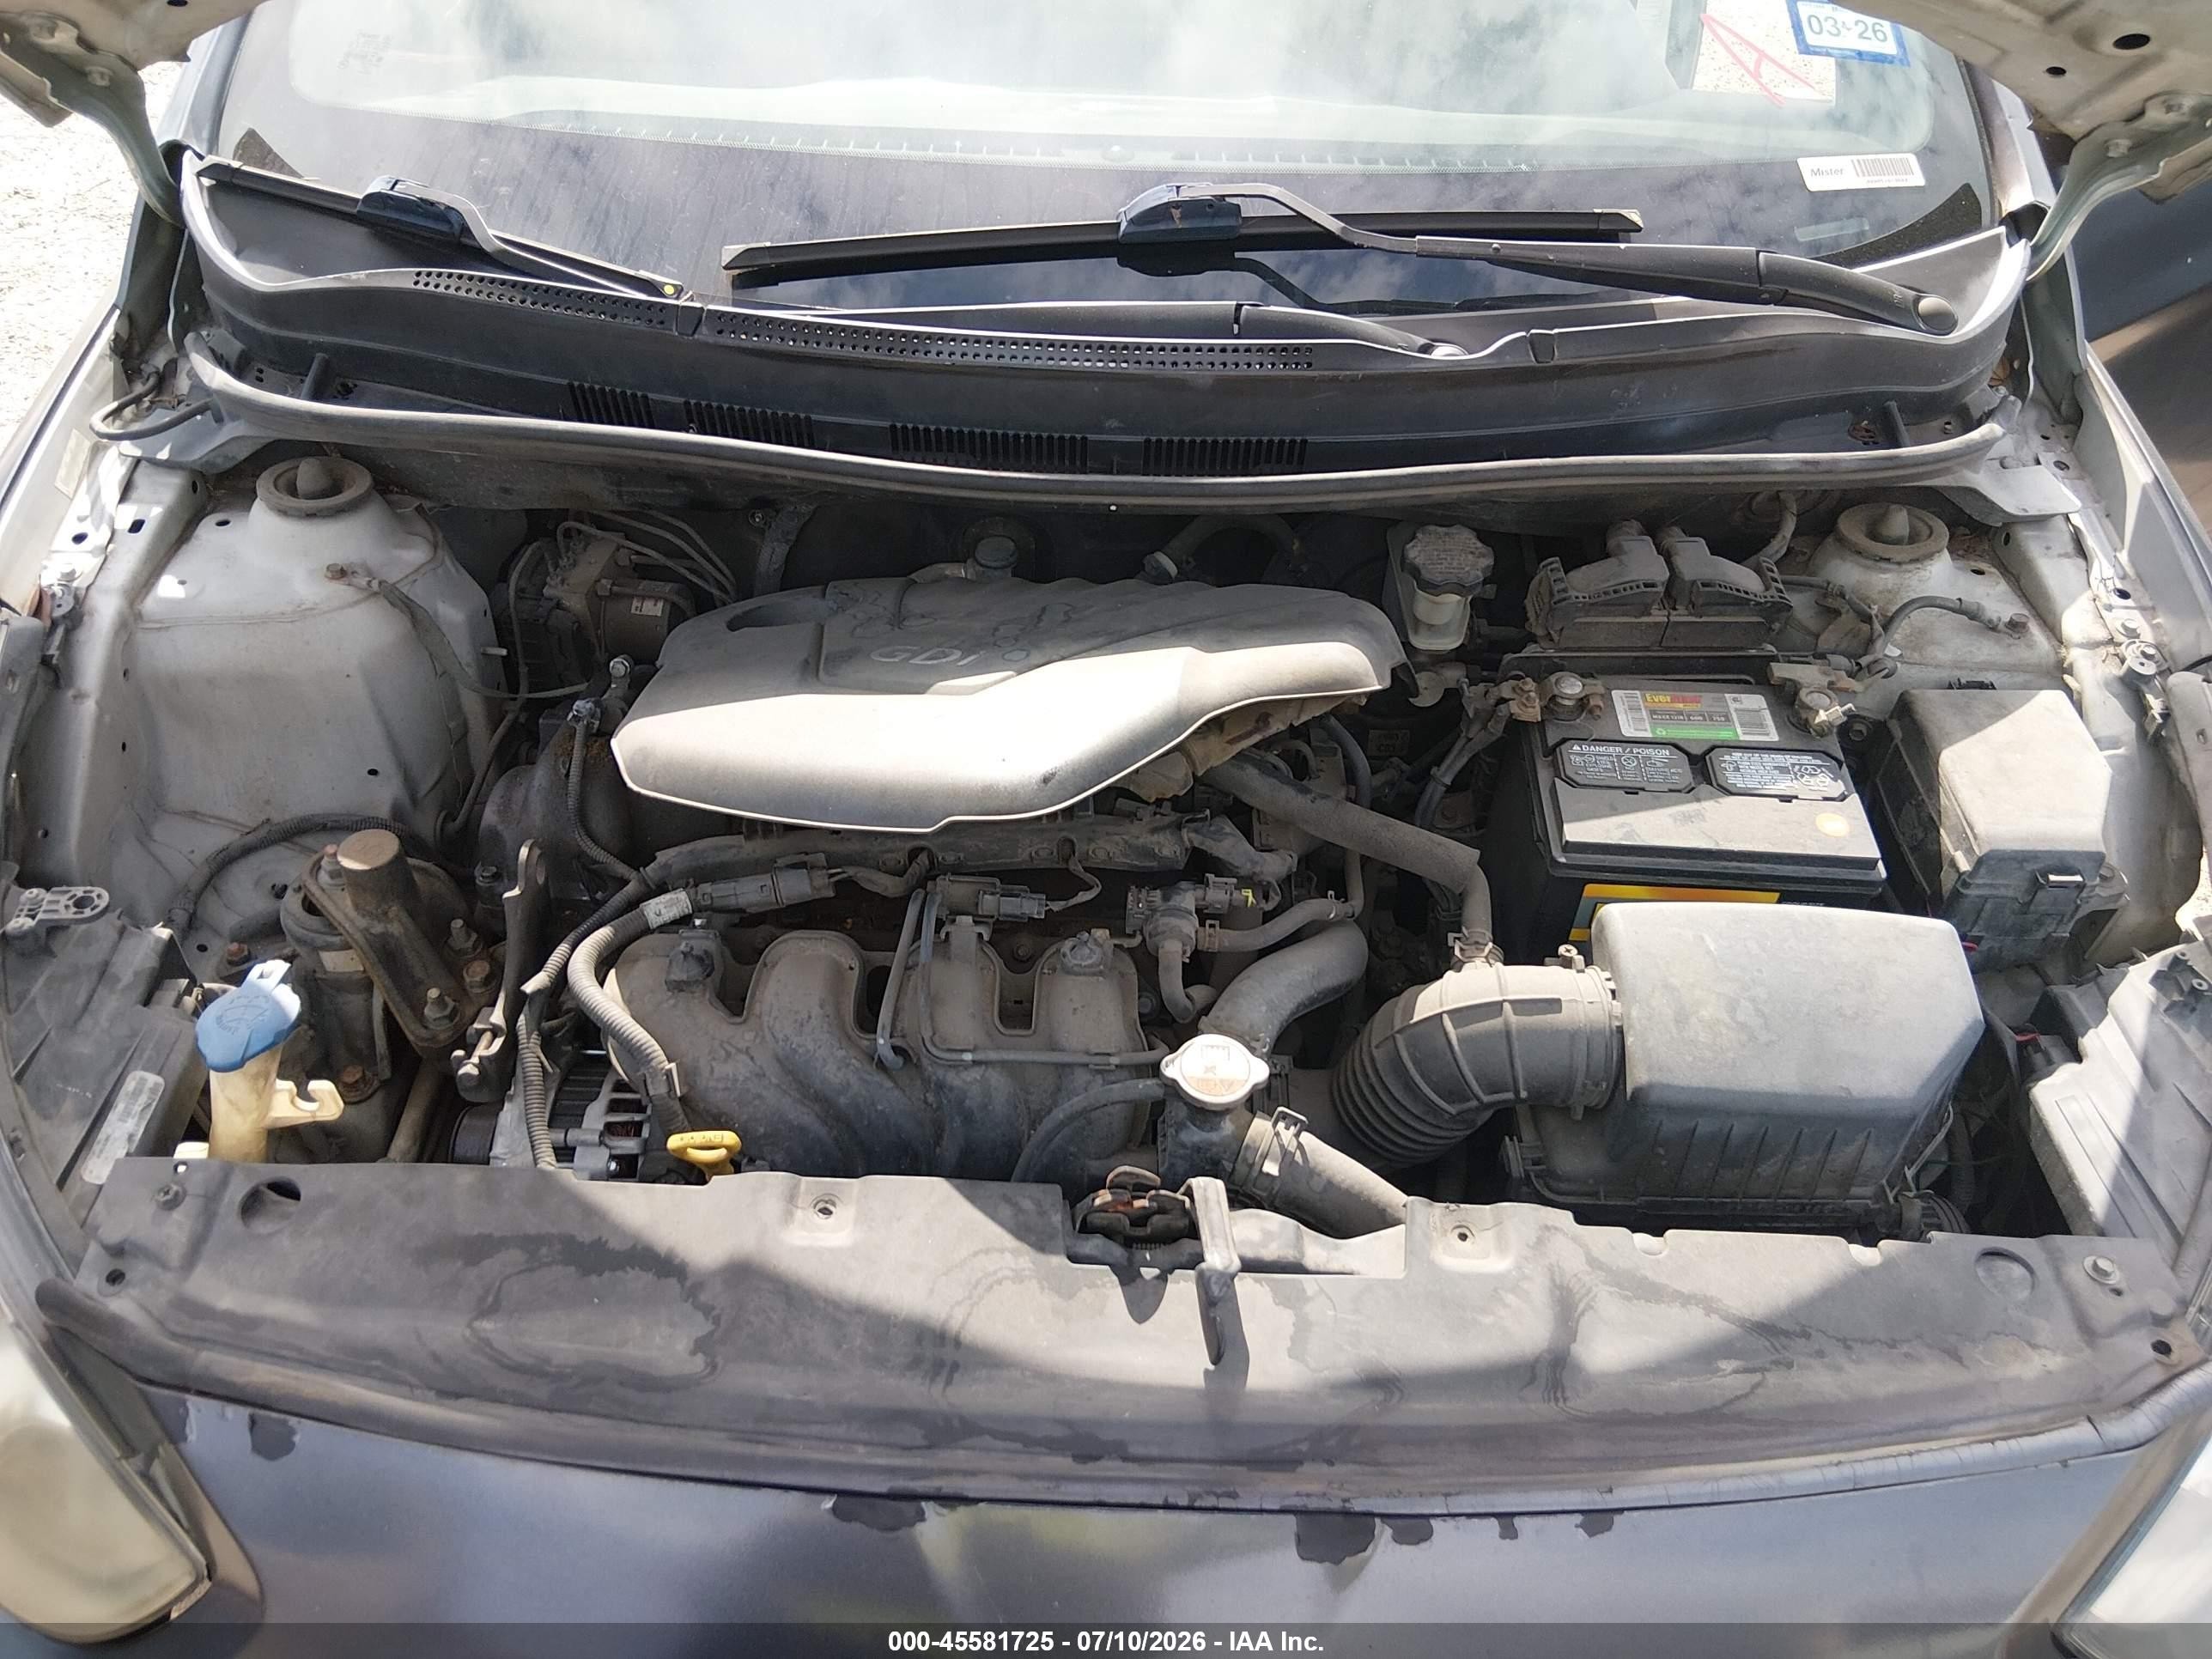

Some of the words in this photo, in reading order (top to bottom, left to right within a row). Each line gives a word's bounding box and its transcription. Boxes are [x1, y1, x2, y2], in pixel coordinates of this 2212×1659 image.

[1807, 14, 1842, 37] 03
[1854, 19, 1888, 43] 26
[1582, 744, 1623, 754] DANGER
